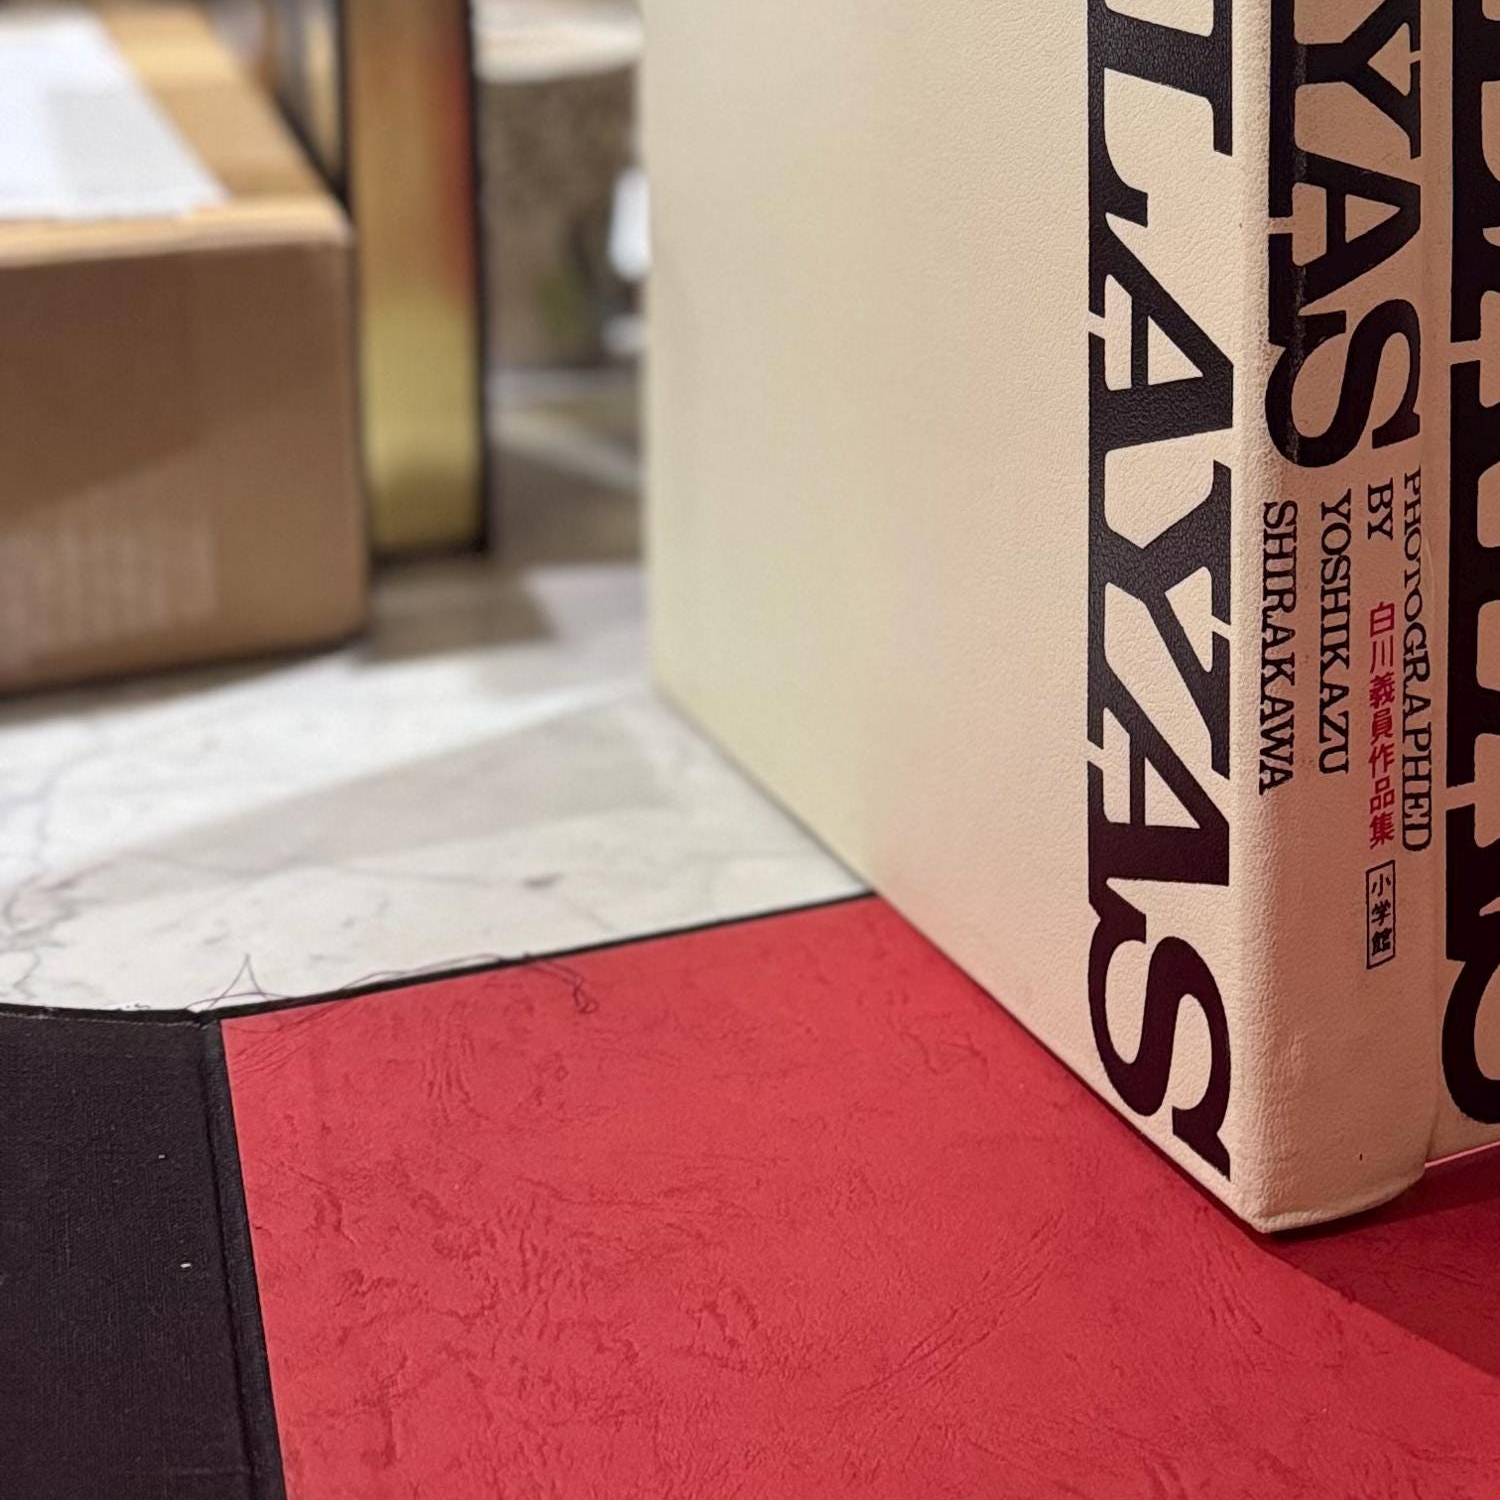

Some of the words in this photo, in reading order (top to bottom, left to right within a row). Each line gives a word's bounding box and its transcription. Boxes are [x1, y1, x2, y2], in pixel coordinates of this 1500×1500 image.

[1318, 487, 1352, 775] YOSHIKAZU
[1367, 476, 1395, 541] BY
[1258, 499, 1299, 796] SHIRAKAWA
[1368, 601, 1397, 850] 白川義員作品集
[1402, 464, 1433, 852] PHOTOGRAPHED
[1370, 872, 1394, 958] 小学館
